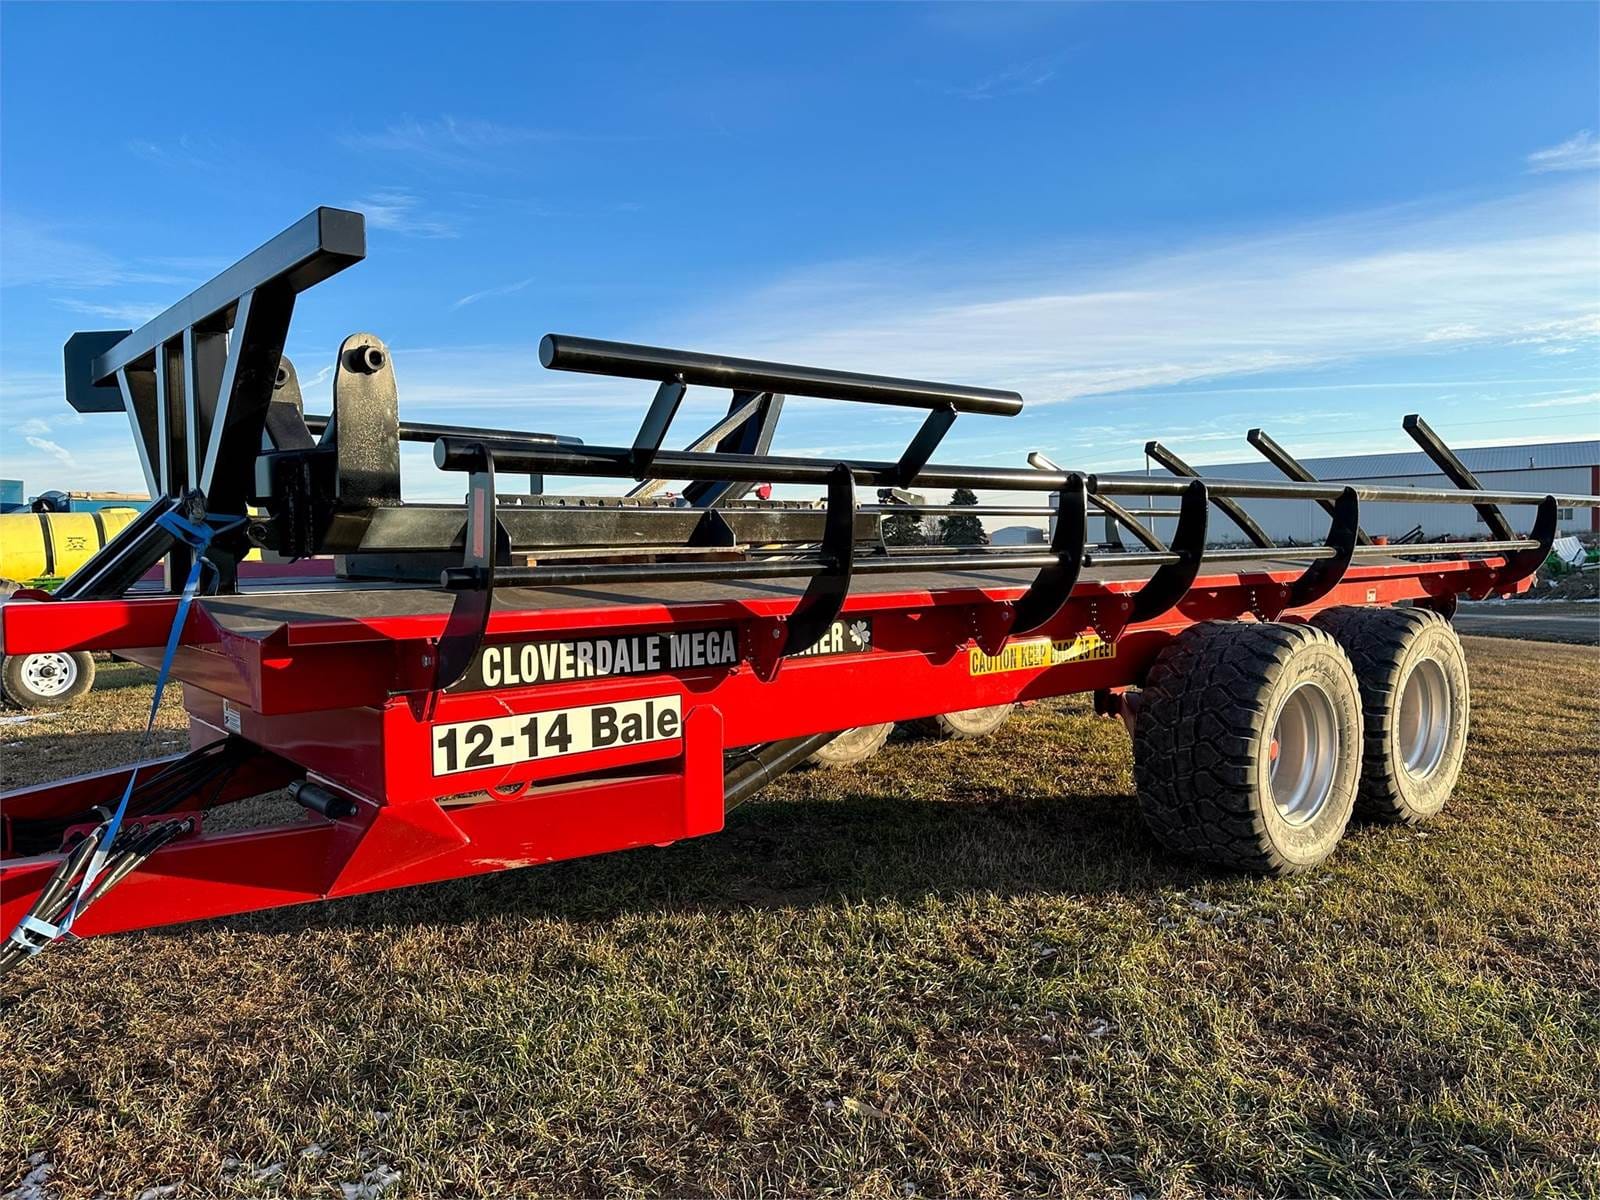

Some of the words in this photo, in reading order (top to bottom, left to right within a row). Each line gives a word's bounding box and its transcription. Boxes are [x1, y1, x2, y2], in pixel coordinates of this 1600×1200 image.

[482, 636, 660, 687] CLOVERDALE
[670, 630, 736, 668] MEGA
[1021, 644, 1046, 667] KEEP
[1094, 638, 1114, 659] FEET
[438, 713, 572, 772] 12-14
[591, 701, 679, 749] Bale
